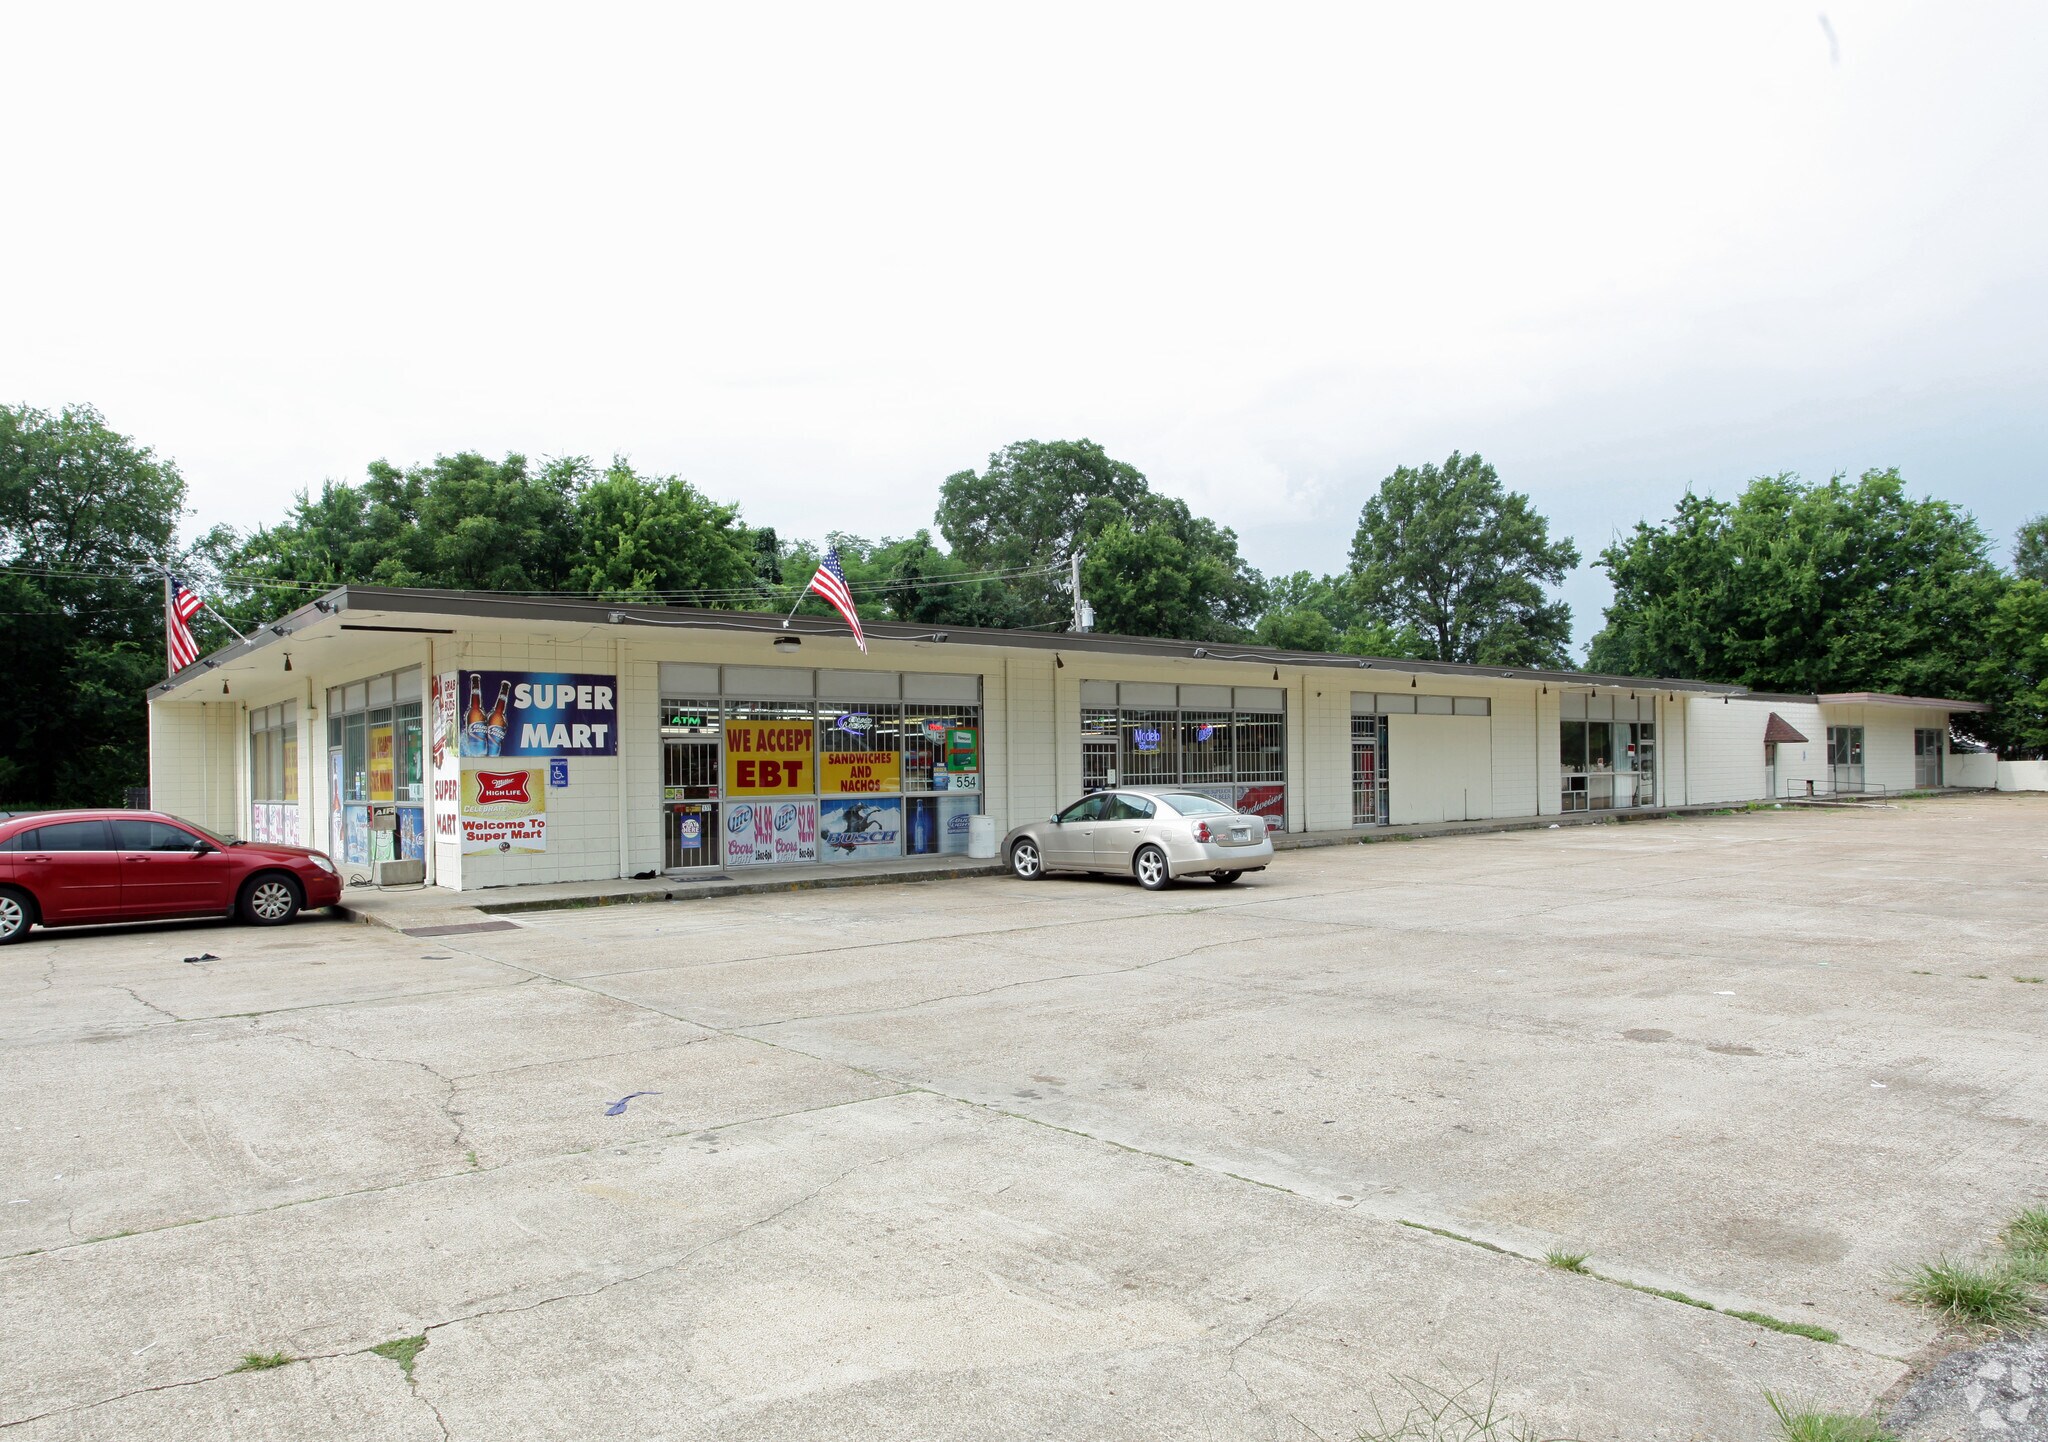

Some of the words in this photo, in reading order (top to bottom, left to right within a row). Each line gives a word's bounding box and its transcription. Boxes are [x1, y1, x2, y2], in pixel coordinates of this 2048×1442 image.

[514, 683, 613, 710] SUPER
[672, 716, 701, 725] ATM
[520, 723, 608, 748] MART
[727, 729, 751, 752] WE
[756, 729, 812, 752] ACCEPT
[1135, 729, 1160, 742] Modelo
[828, 753, 892, 764] SANDWICHES
[737, 760, 802, 788] EBT
[850, 766, 872, 778] AND
[492, 778, 514, 788] Miller
[840, 779, 881, 792] NACHOS
[435, 779, 457, 801] SUPER
[1239, 793, 1283, 815] Budweiser
[375, 807, 395, 816] AIR
[437, 814, 456, 835] MART
[462, 821, 526, 831] Welcome
[529, 819, 545, 828] To
[754, 804, 772, 845] $4.99
[798, 803, 815, 843] $2.99
[466, 832, 507, 842] Super
[511, 830, 542, 839] Mart
[827, 831, 899, 844] BUSCH
[728, 840, 754, 855] Coors
[775, 838, 798, 853] Coors
[730, 855, 752, 864] LIGHT
[776, 853, 797, 862] LIGHT
